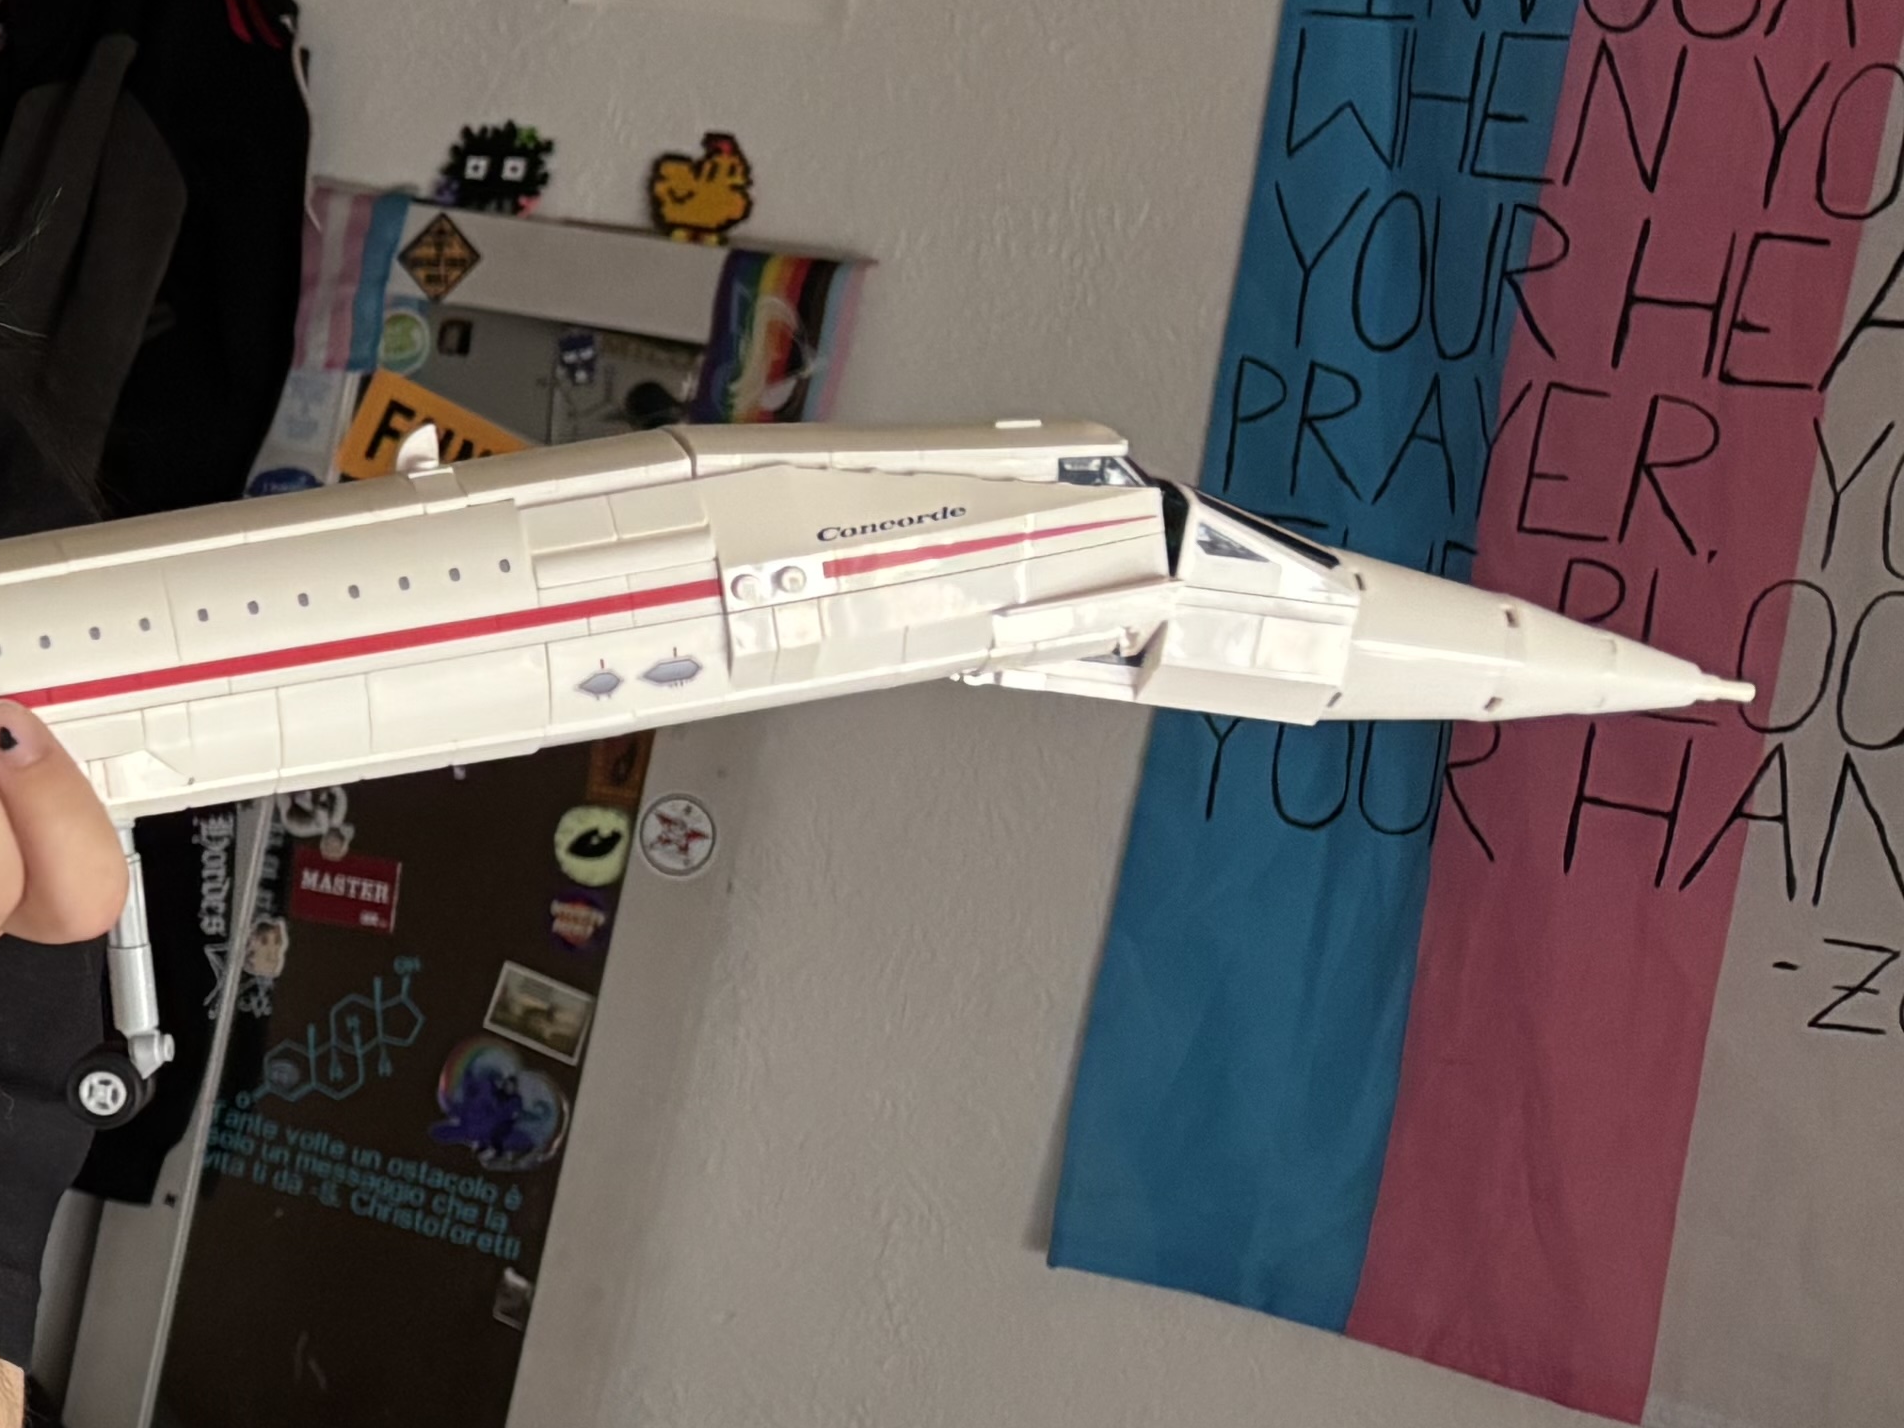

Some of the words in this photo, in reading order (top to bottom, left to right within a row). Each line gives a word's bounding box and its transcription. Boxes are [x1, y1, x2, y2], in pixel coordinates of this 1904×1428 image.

[1286, 27, 1689, 193] WHEN
[1275, 181, 1570, 361] YOUR
[816, 505, 967, 542] Concorde
[300, 866, 390, 905] MASTER
[260, 1141, 291, 1165] un
[295, 1151, 427, 1210] messaggio
[285, 1124, 346, 1160] volte
[351, 1145, 383, 1170] un
[386, 1156, 499, 1204] ostacolo
